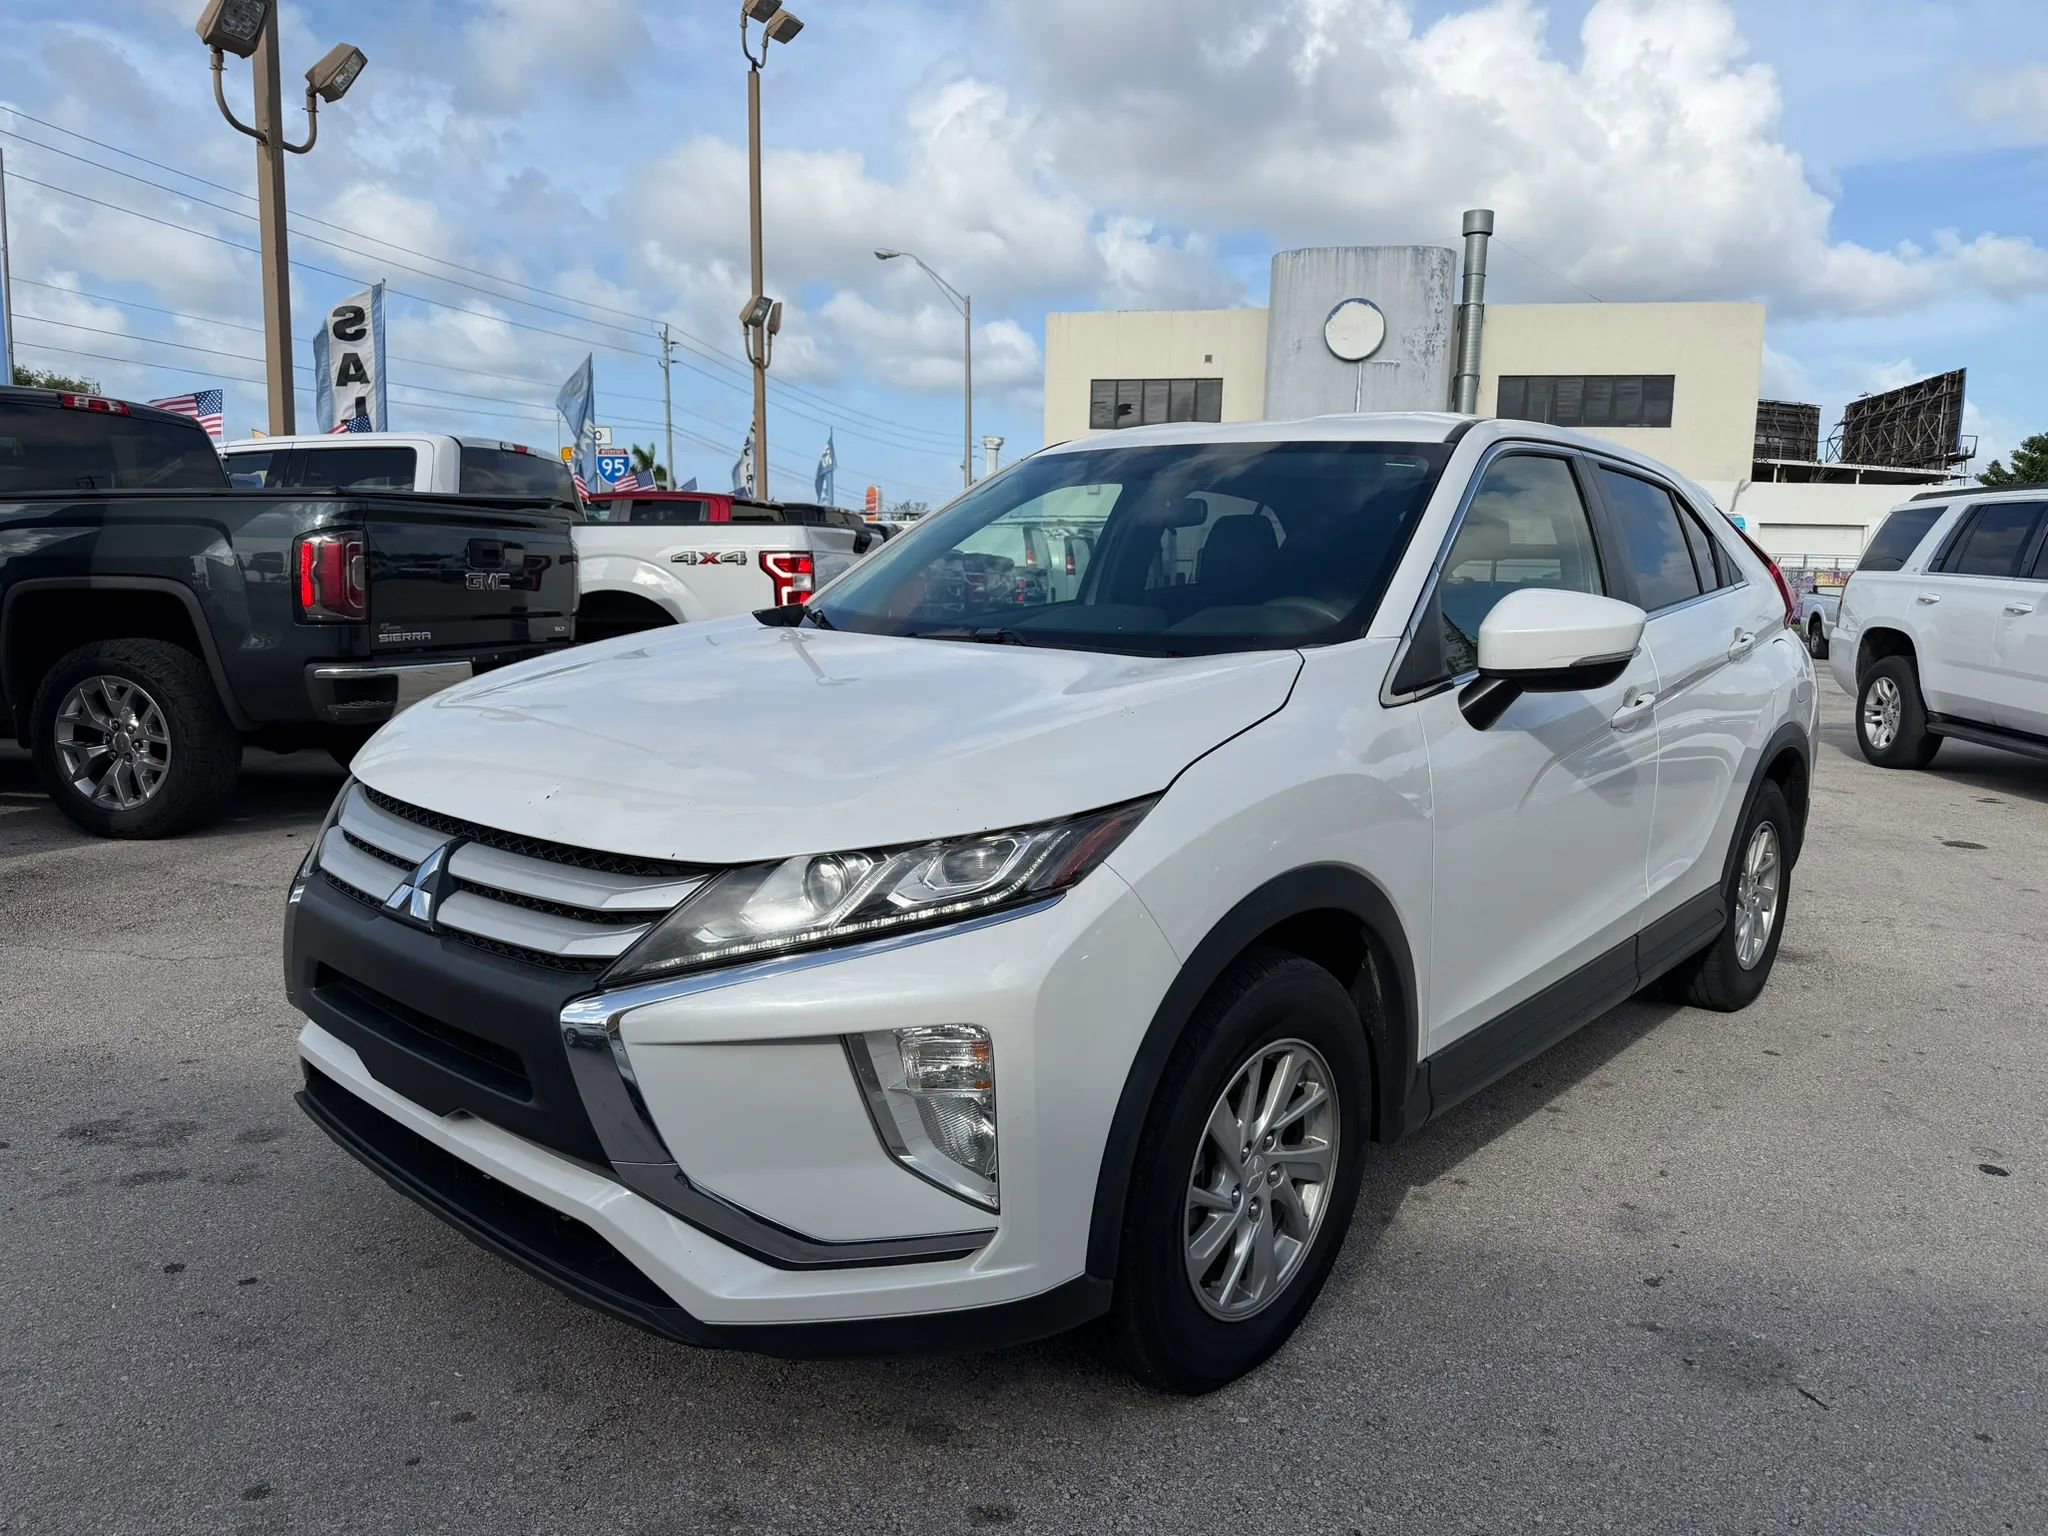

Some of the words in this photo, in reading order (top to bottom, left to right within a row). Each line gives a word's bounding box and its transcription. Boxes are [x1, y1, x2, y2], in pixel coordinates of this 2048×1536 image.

[601, 458, 625, 477] 95
[465, 572, 511, 591] GMC
[378, 631, 432, 643] SIERRA
